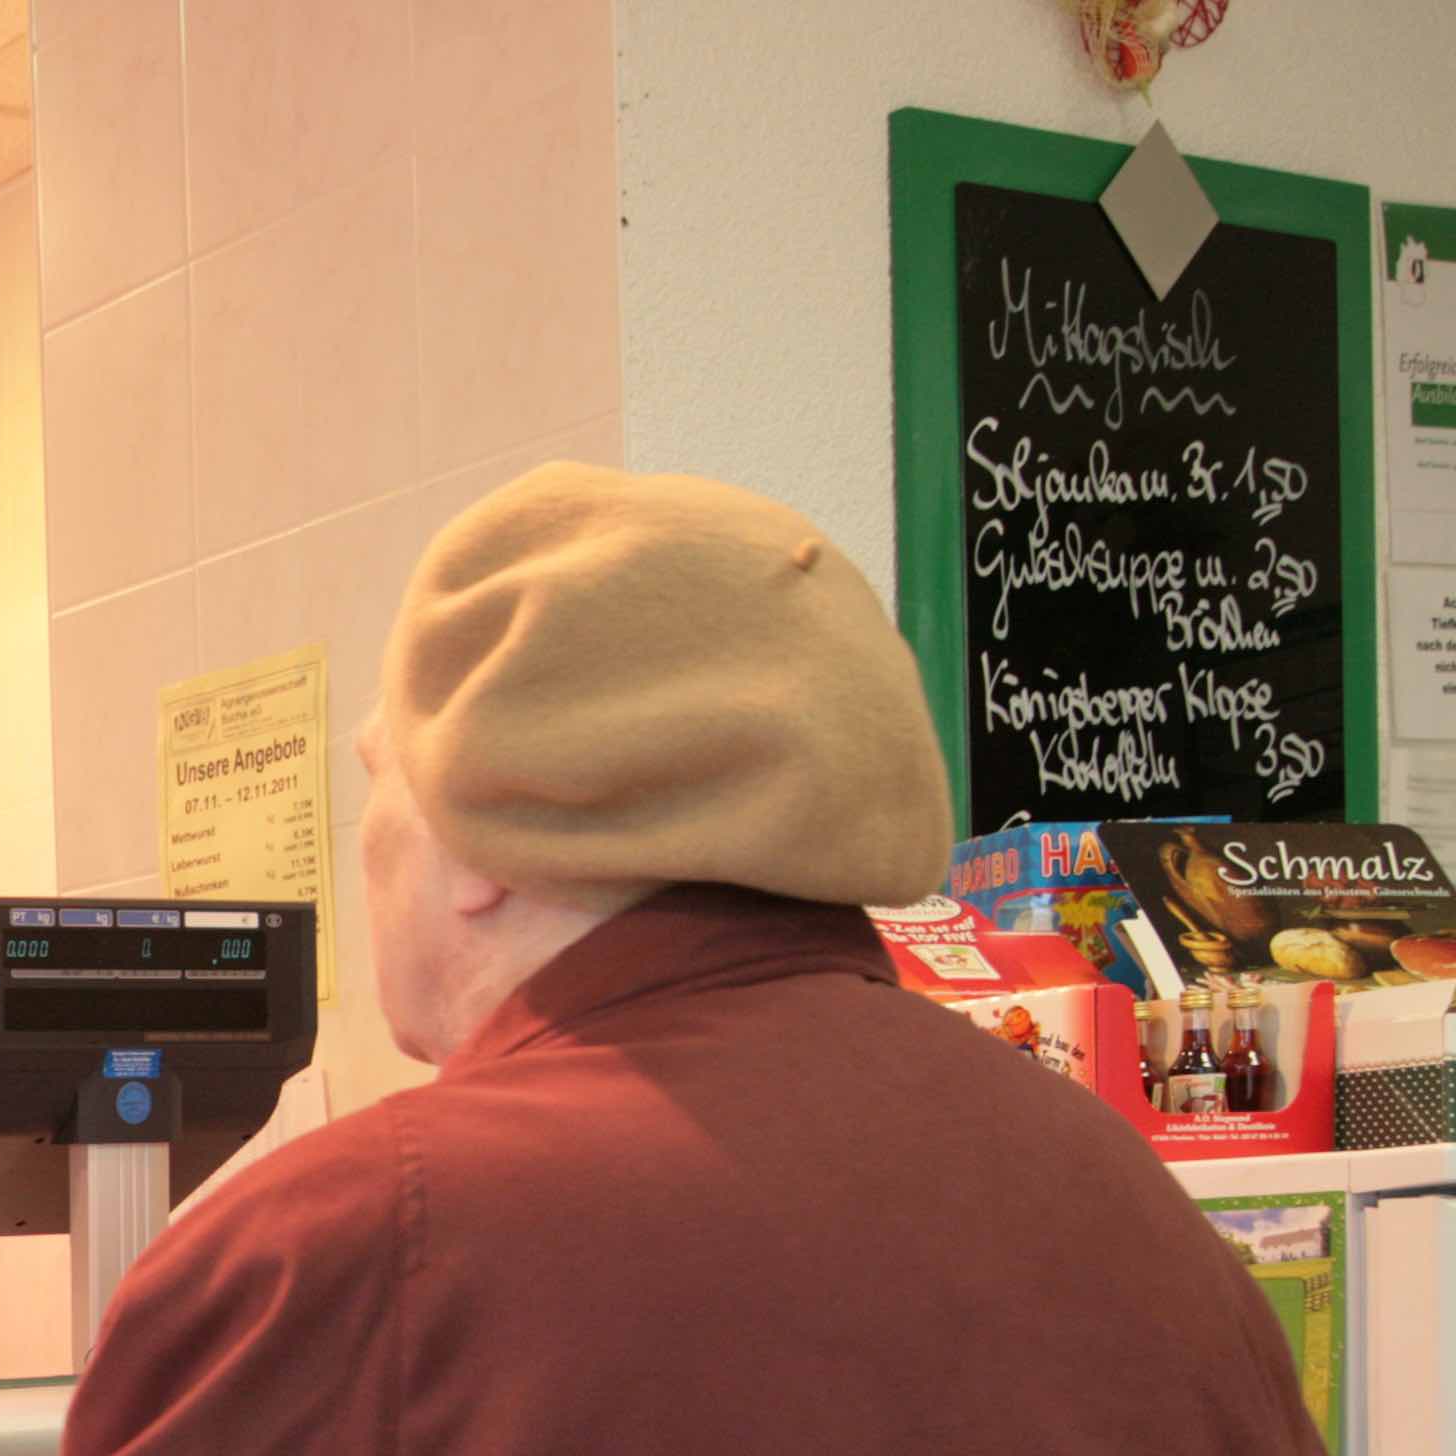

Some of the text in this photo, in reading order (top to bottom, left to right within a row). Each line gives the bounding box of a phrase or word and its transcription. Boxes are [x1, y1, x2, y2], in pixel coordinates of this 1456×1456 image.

[988, 256, 1238, 430] Mittagstisch
[1399, 351, 1456, 379] Erfolgrei
[176, 734, 307, 786] Unsere Angebote
[184, 795, 222, 815] 07.11.
[238, 774, 298, 803] 12.11.2011
[949, 831, 1120, 900] HARIBO HA
[1216, 840, 1434, 887] Schmalz
